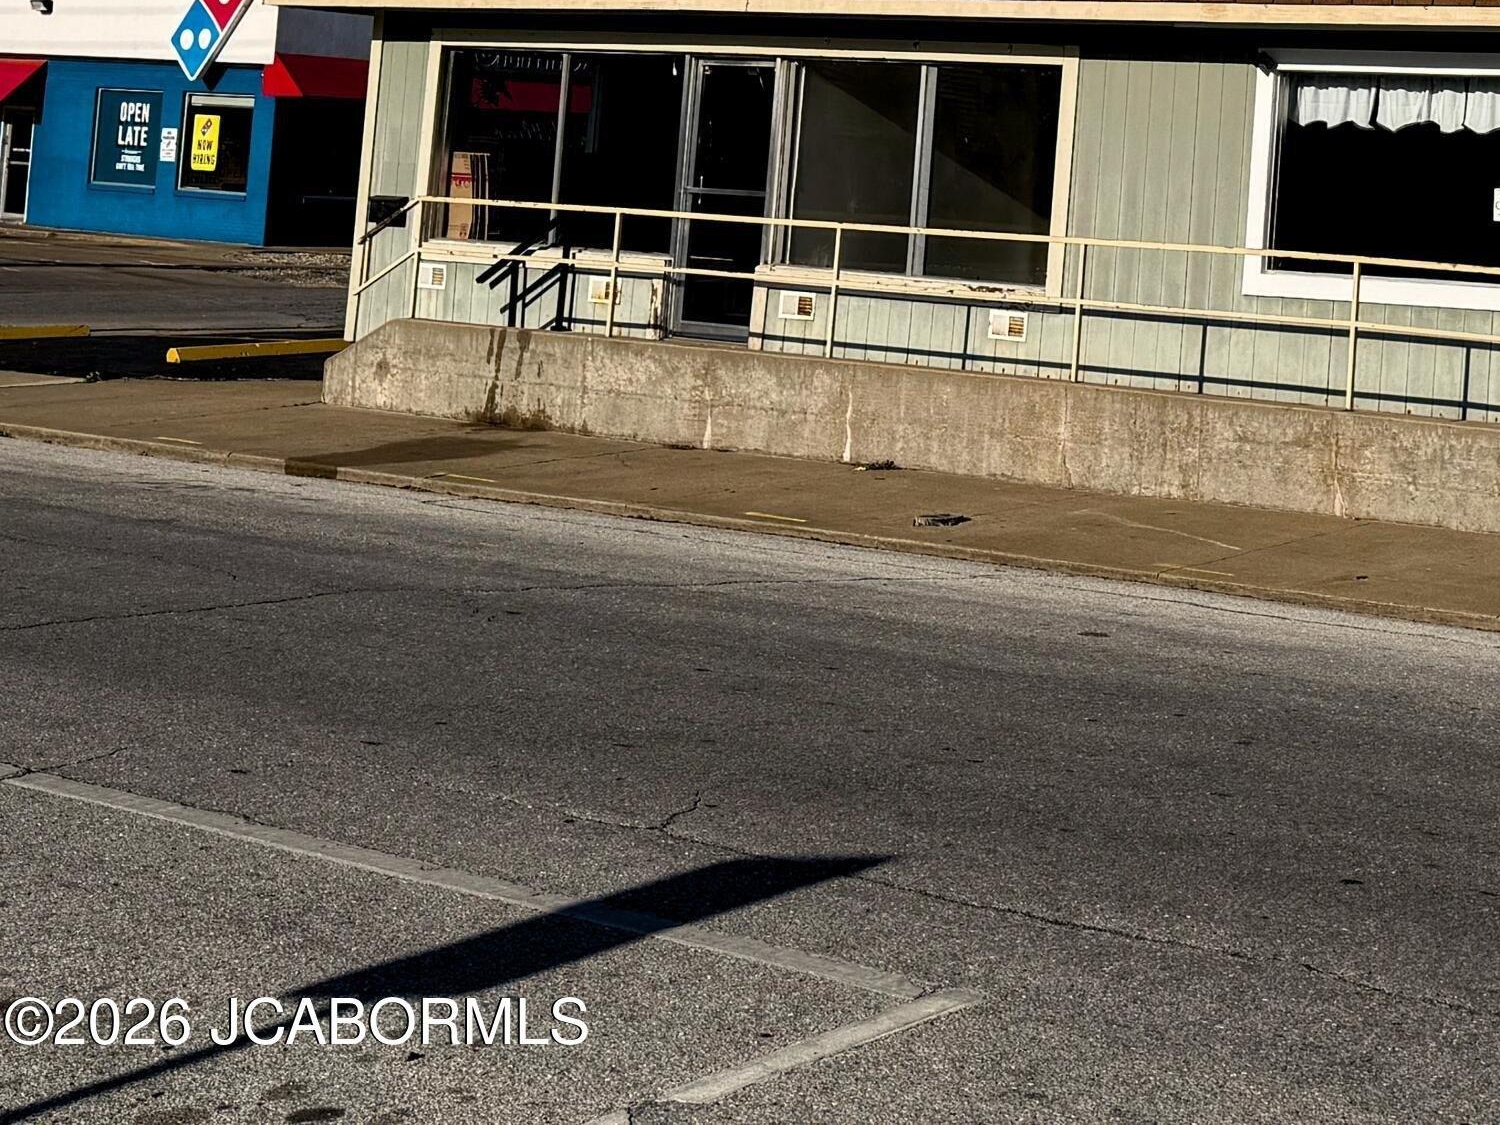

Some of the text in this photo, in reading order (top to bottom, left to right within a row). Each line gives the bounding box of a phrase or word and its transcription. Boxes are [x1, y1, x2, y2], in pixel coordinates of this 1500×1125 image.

[120, 102, 150, 123] OPEN
[118, 126, 148, 146] LATE
[197, 140, 213, 151] NOW
[193, 154, 215, 165] HIRING
